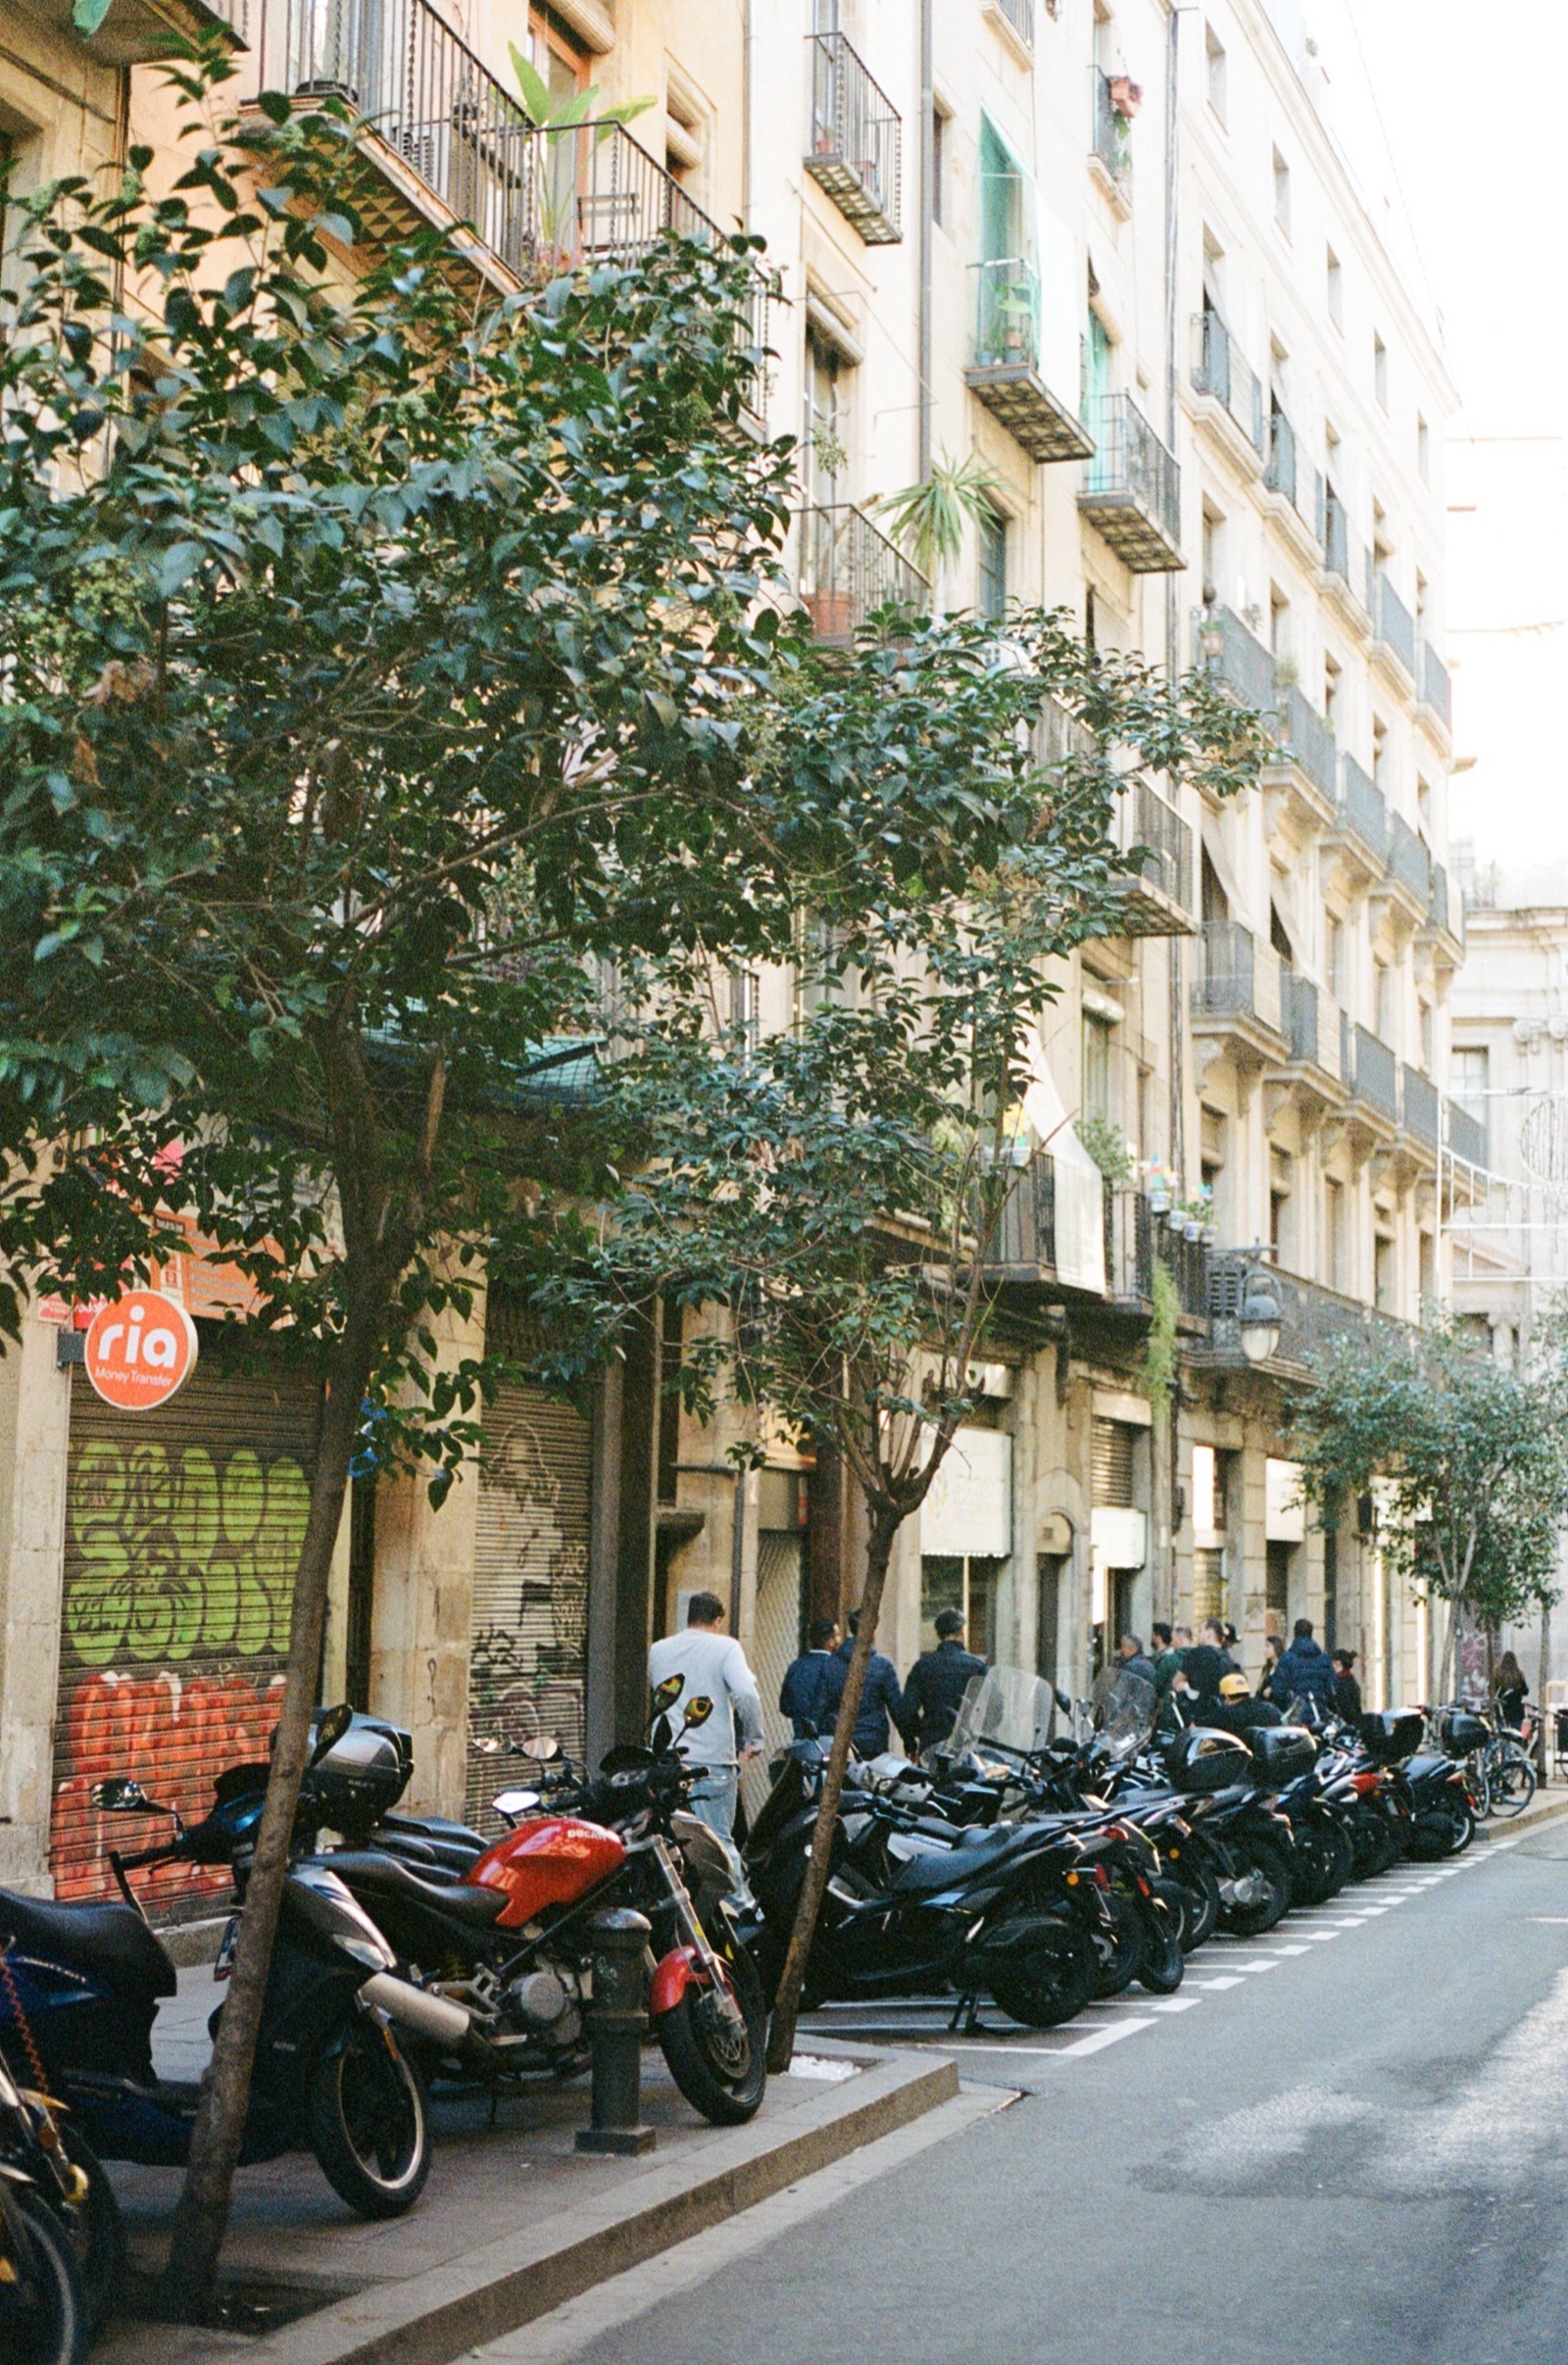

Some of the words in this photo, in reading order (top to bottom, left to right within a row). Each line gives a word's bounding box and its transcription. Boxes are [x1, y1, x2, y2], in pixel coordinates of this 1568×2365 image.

[98, 1305, 177, 1368] ria
[95, 1366, 128, 1384] Money
[130, 1369, 172, 1387] Transfer
